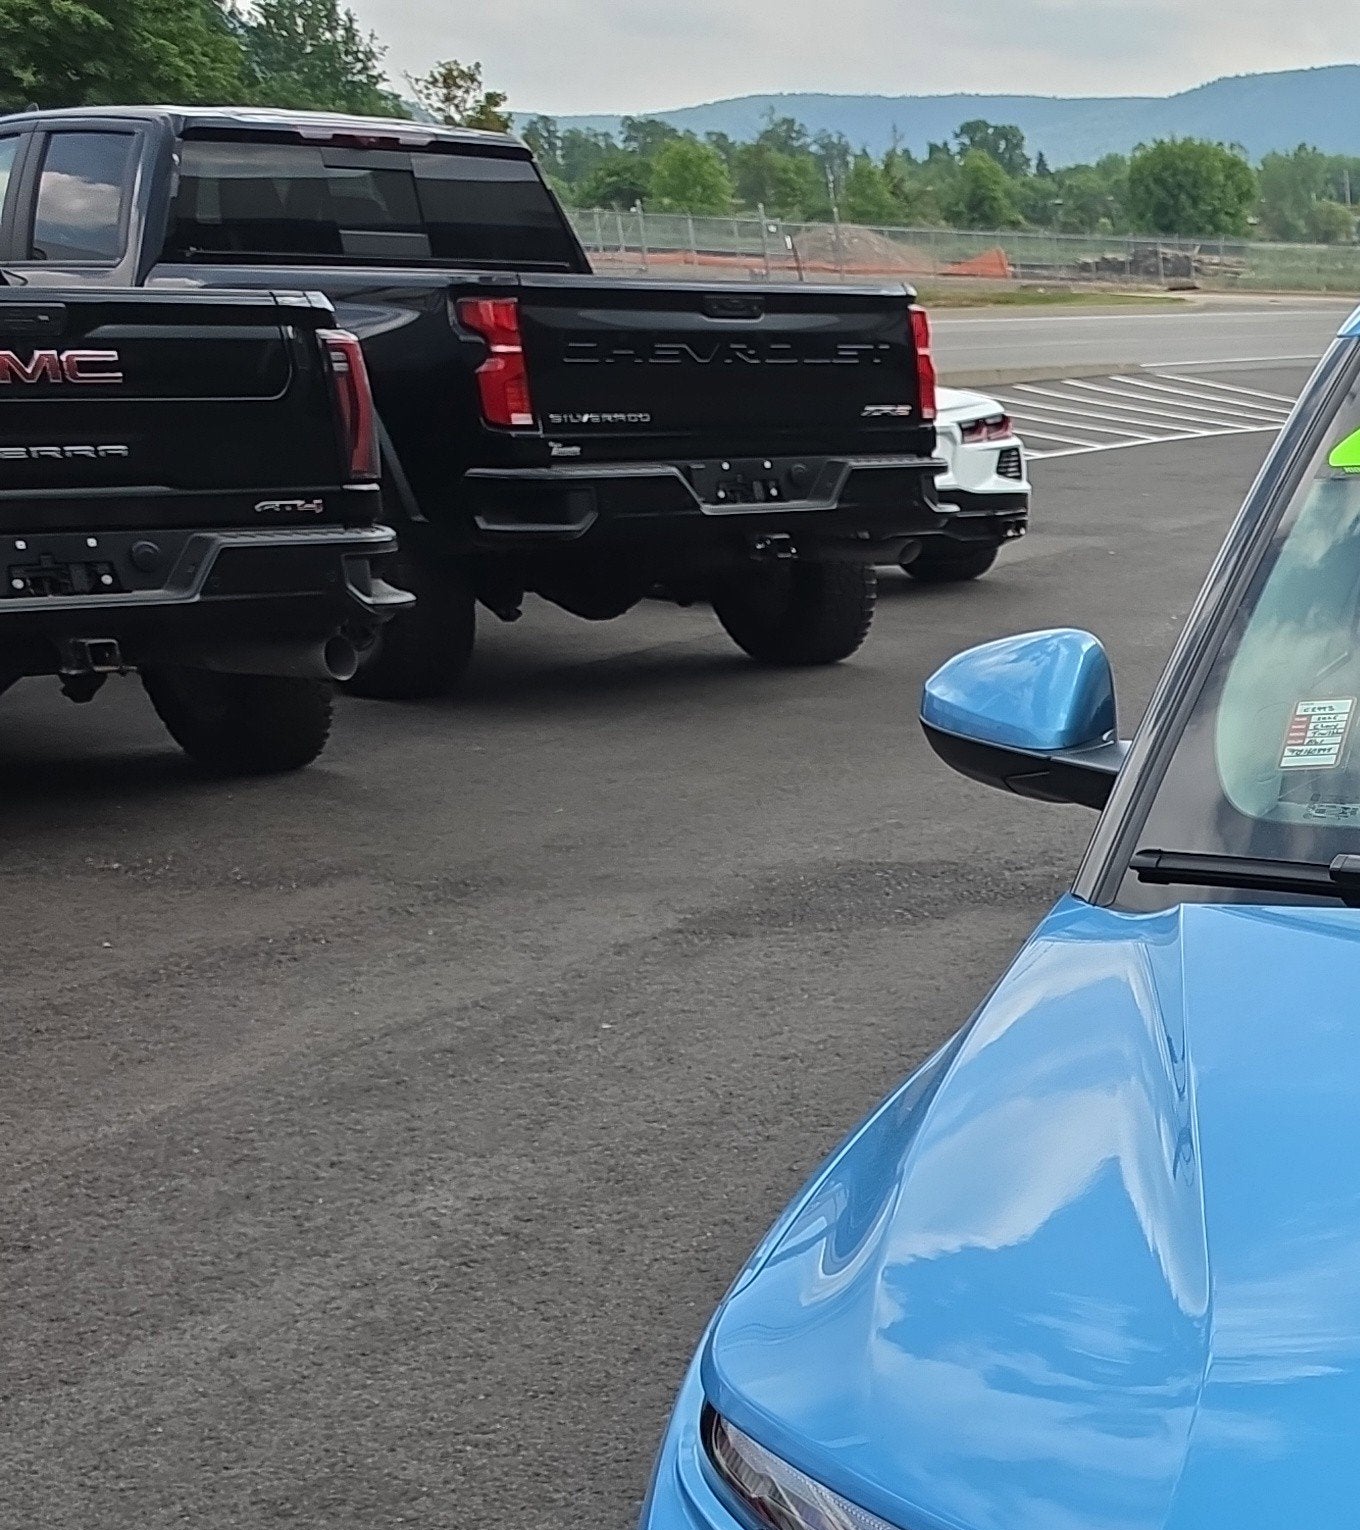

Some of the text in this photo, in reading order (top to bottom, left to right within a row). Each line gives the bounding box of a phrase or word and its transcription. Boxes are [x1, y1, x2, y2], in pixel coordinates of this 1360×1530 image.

[0, 350, 122, 383] MC
[549, 413, 651, 423] SILVERADO
[0, 445, 129, 459] ERRA
